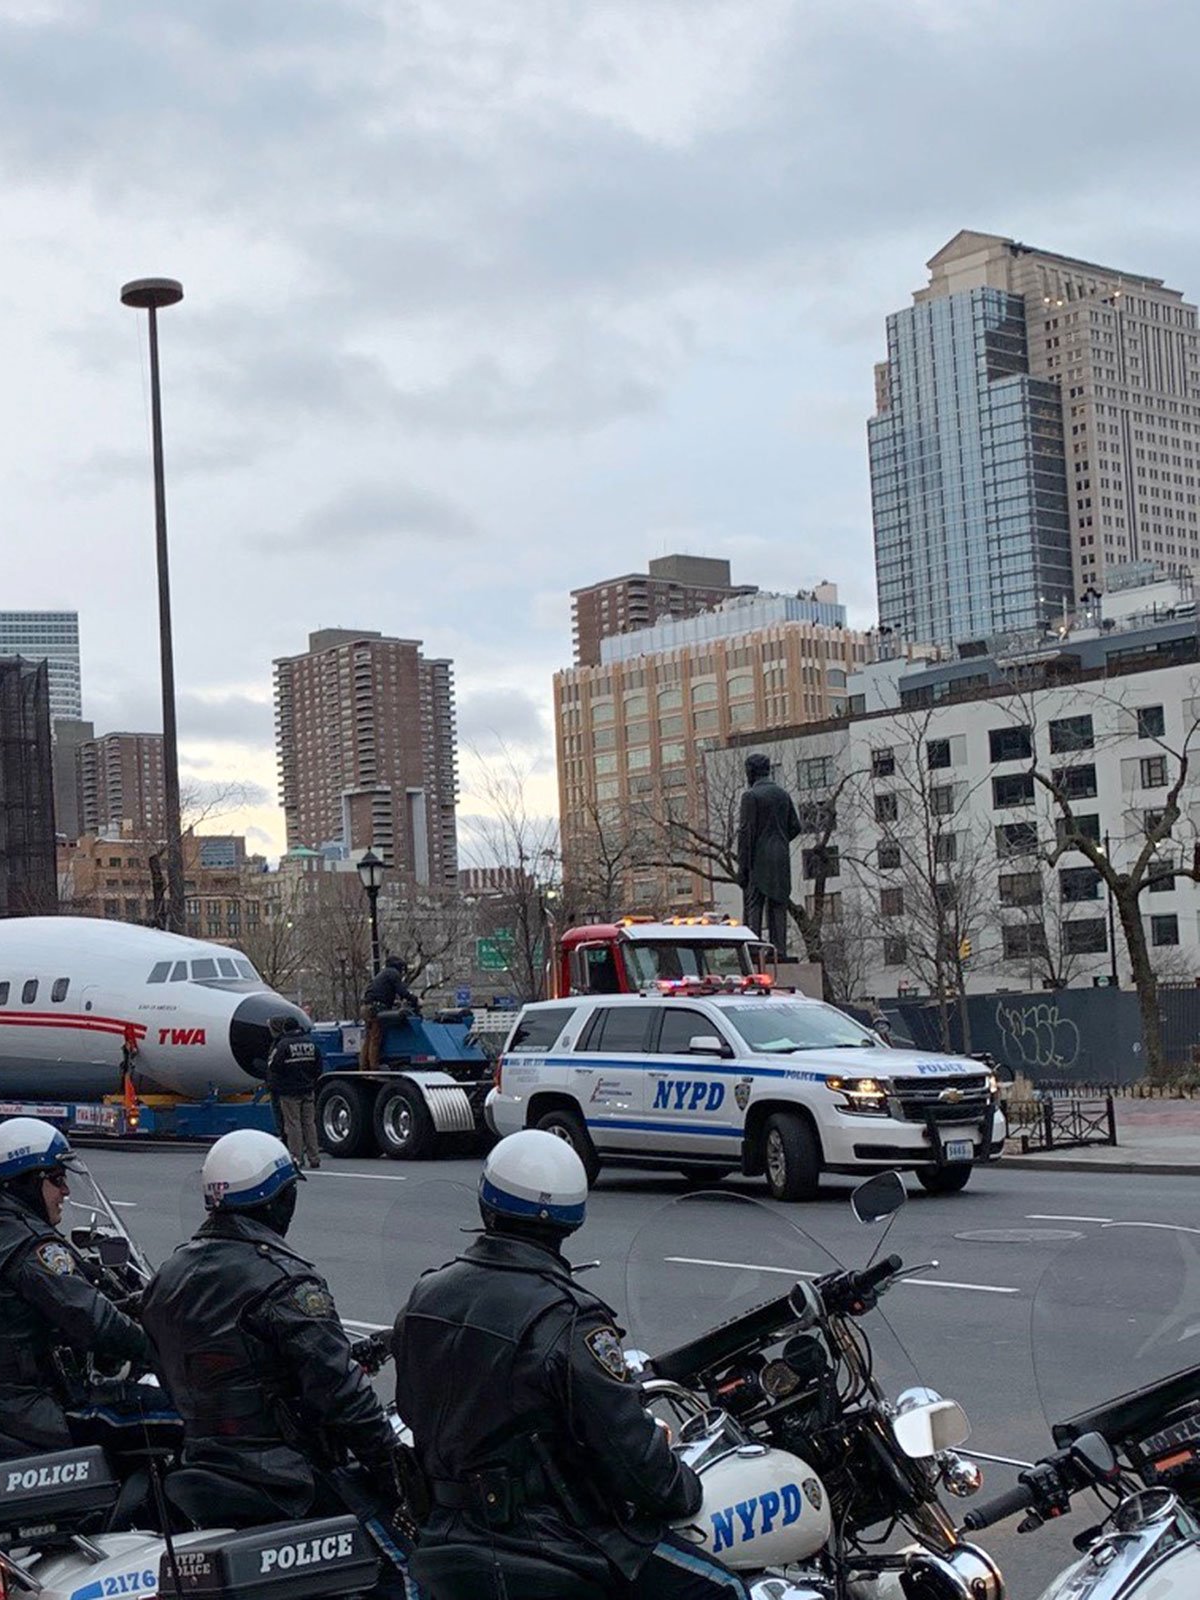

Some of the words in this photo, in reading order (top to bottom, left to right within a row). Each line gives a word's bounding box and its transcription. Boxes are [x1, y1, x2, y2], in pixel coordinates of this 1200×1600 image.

[158, 1028, 206, 1045] TWA
[289, 1042, 315, 1052] NYPD
[785, 1070, 815, 1082] POLICE
[916, 1063, 966, 1074] POLICE
[653, 1080, 725, 1111] NYPD
[6, 1461, 90, 1492] POLICE
[709, 1483, 802, 1553] NYPD
[260, 1533, 353, 1574] POLICE
[104, 1570, 157, 1596] 2176
